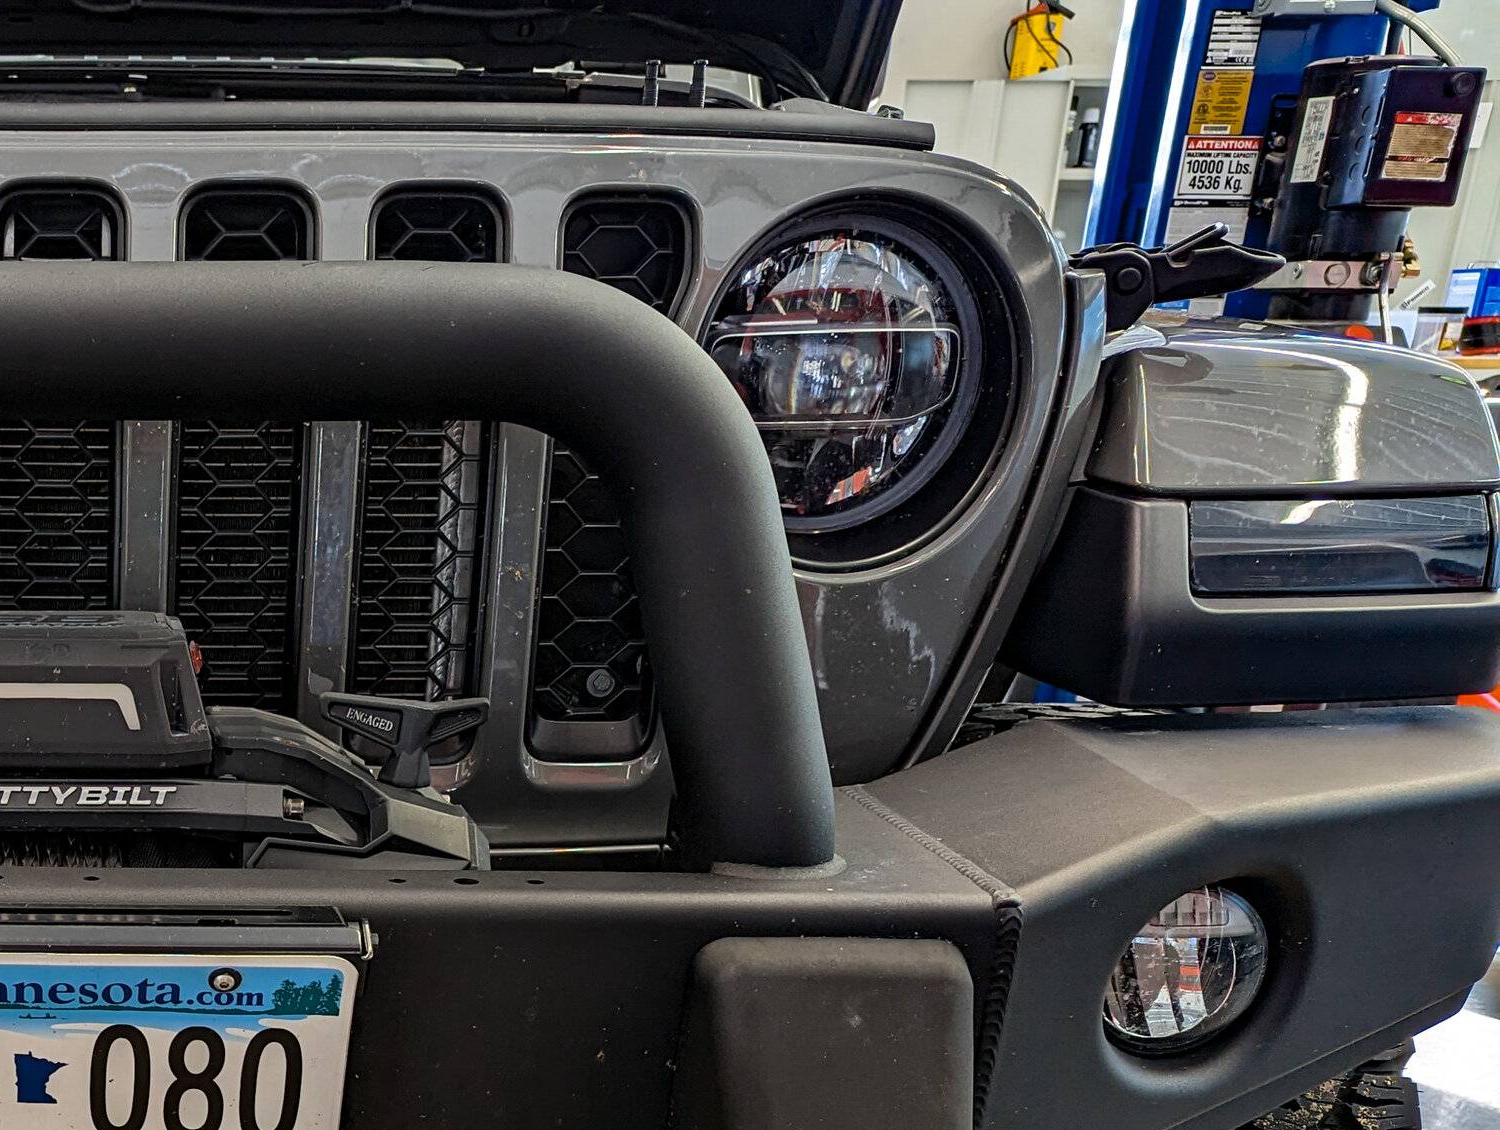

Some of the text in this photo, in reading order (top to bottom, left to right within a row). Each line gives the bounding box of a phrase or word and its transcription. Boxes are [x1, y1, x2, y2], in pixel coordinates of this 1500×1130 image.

[1195, 140, 1253, 149] ATTENTION
[1186, 159, 1252, 175] 10000 Lbs.
[1188, 175, 1242, 193] 4536 Kg.
[346, 707, 393, 732] ENGAGED
